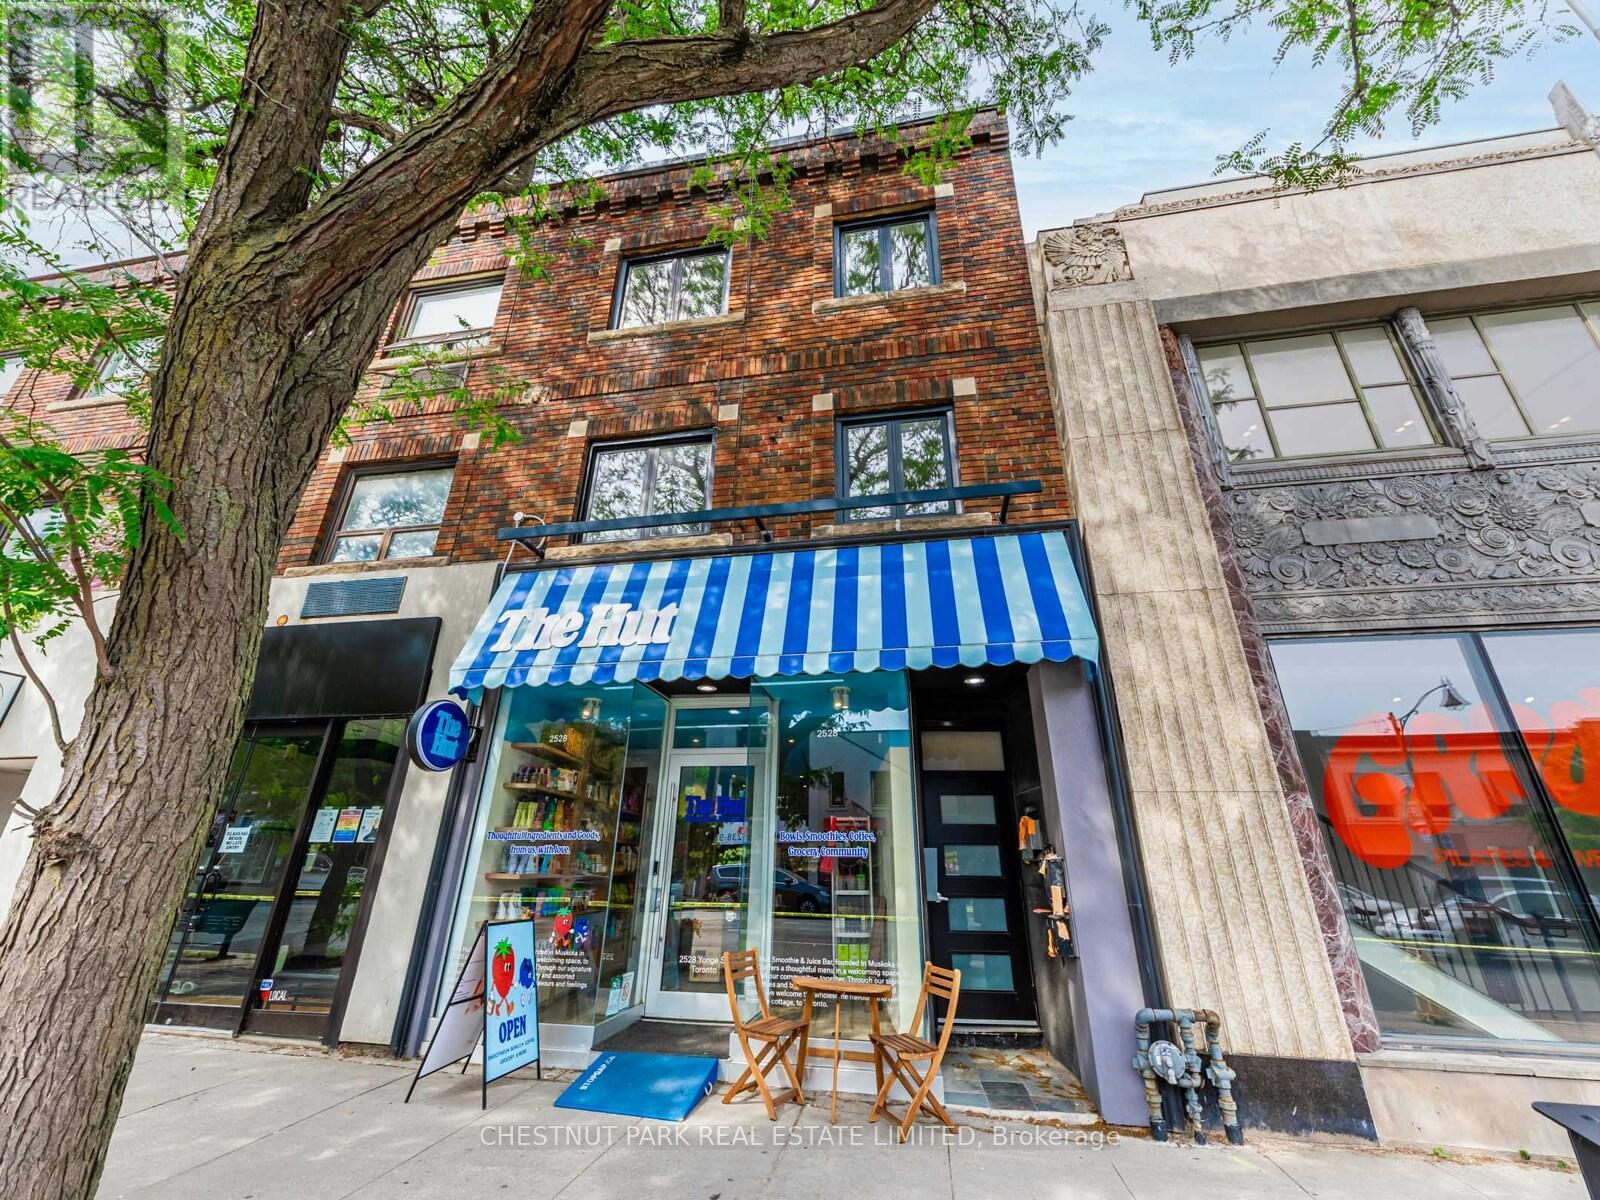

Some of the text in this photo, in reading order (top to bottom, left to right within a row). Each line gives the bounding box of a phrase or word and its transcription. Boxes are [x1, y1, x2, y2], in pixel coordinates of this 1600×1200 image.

[490, 602, 679, 653] The Hut
[431, 710, 462, 759] The Hut
[817, 728, 838, 737] 2528
[487, 831, 523, 842] Thoughtful
[563, 831, 577, 840] and
[577, 830, 600, 842] Goods,
[848, 831, 876, 843] Coffee,
[511, 844, 527, 854] from
[537, 844, 553, 854] with
[553, 844, 571, 854] love.
[788, 846, 869, 859] Grocery, Community
[1433, 848, 1531, 868] PILATES
[679, 955, 696, 964] 2528
[697, 955, 718, 965] Yonge
[772, 956, 799, 964] Smoothie
[806, 957, 821, 965] Juice
[692, 966, 717, 974] Toronto
[786, 965, 816, 973] thoughtful
[848, 968, 880, 976] welcoming
[566, 981, 588, 990] feelings
[269, 990, 288, 1001] LOCAL
[776, 990, 802, 998] welcome
[499, 1015, 527, 1044] OPEN
